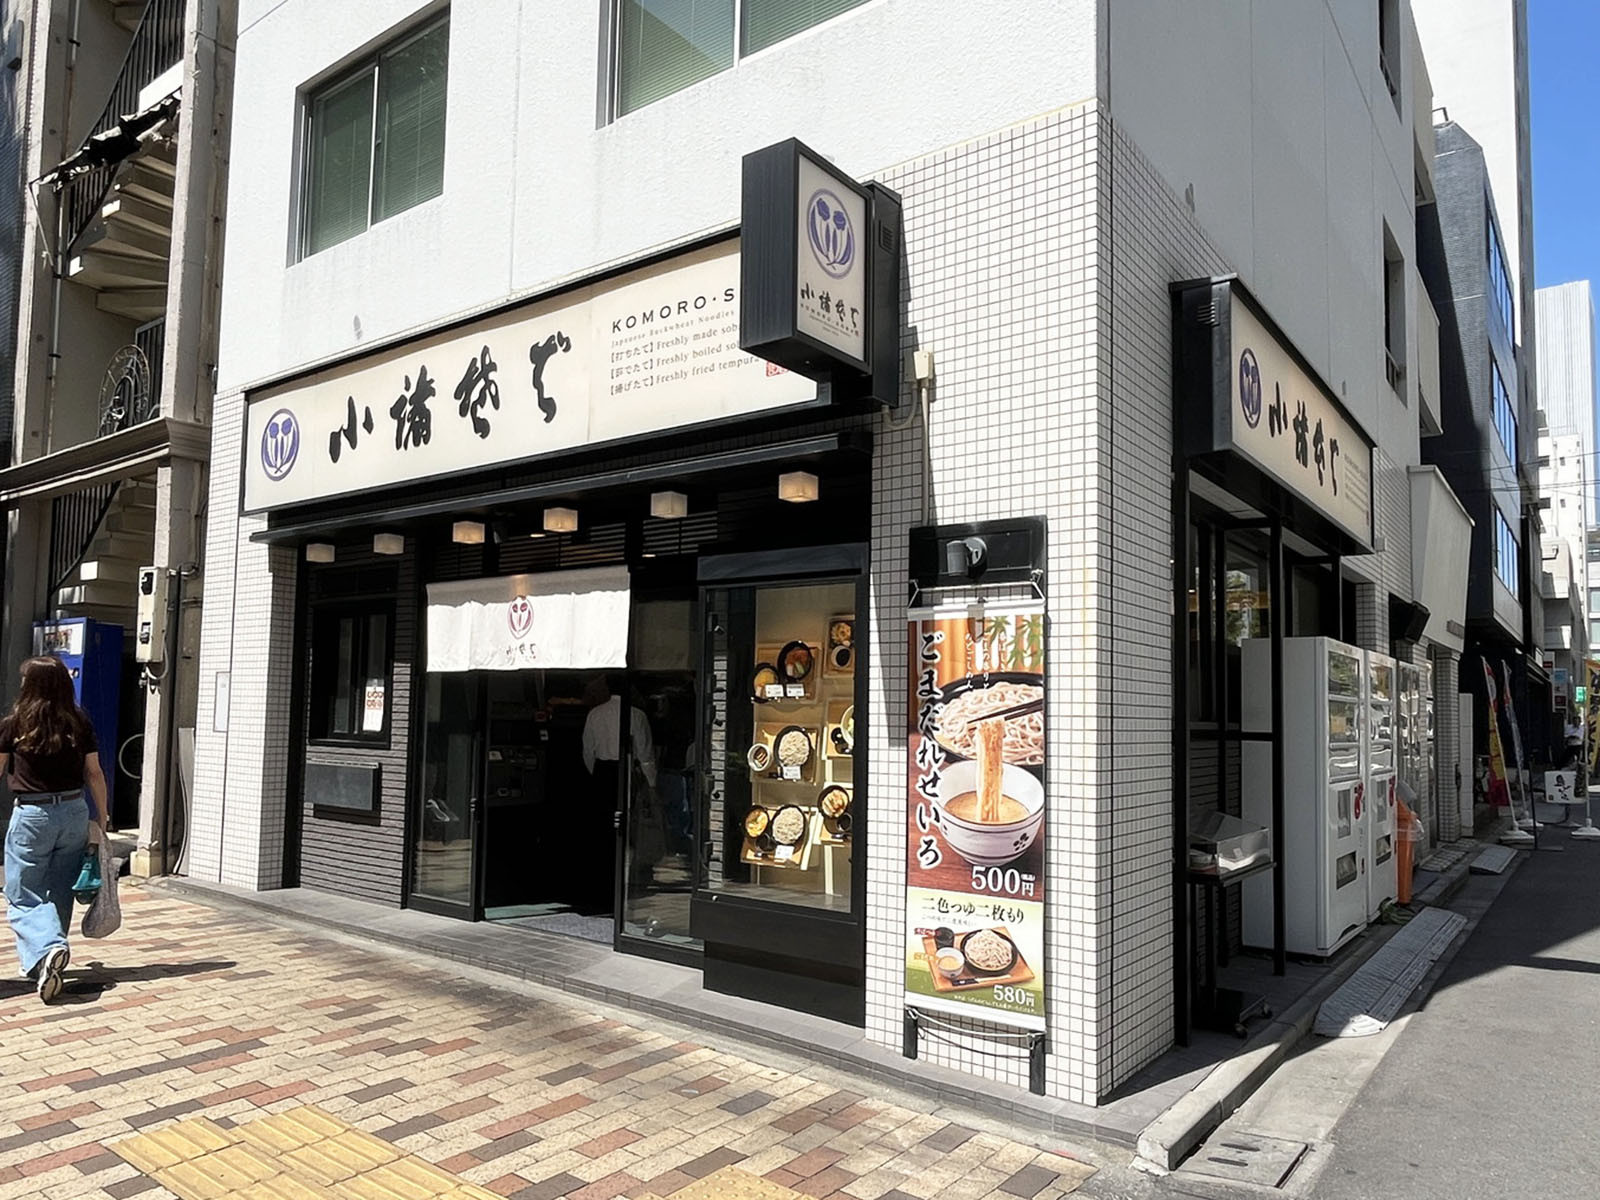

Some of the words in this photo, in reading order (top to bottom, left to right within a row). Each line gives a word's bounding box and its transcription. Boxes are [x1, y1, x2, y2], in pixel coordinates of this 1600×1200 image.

[656, 336, 689, 350] Freshly
[693, 328, 718, 341] made
[721, 323, 740, 334] sob
[656, 353, 689, 367] Freshly
[692, 344, 722, 359] boiled
[656, 370, 689, 384] Freshly
[692, 363, 715, 376] fried
[917, 633, 944, 867] ごまだれせいろ
[971, 866, 1035, 897] 500円
[922, 897, 1024, 923] 二色つゆ二枚もり
[993, 984, 1035, 1006] 580円
